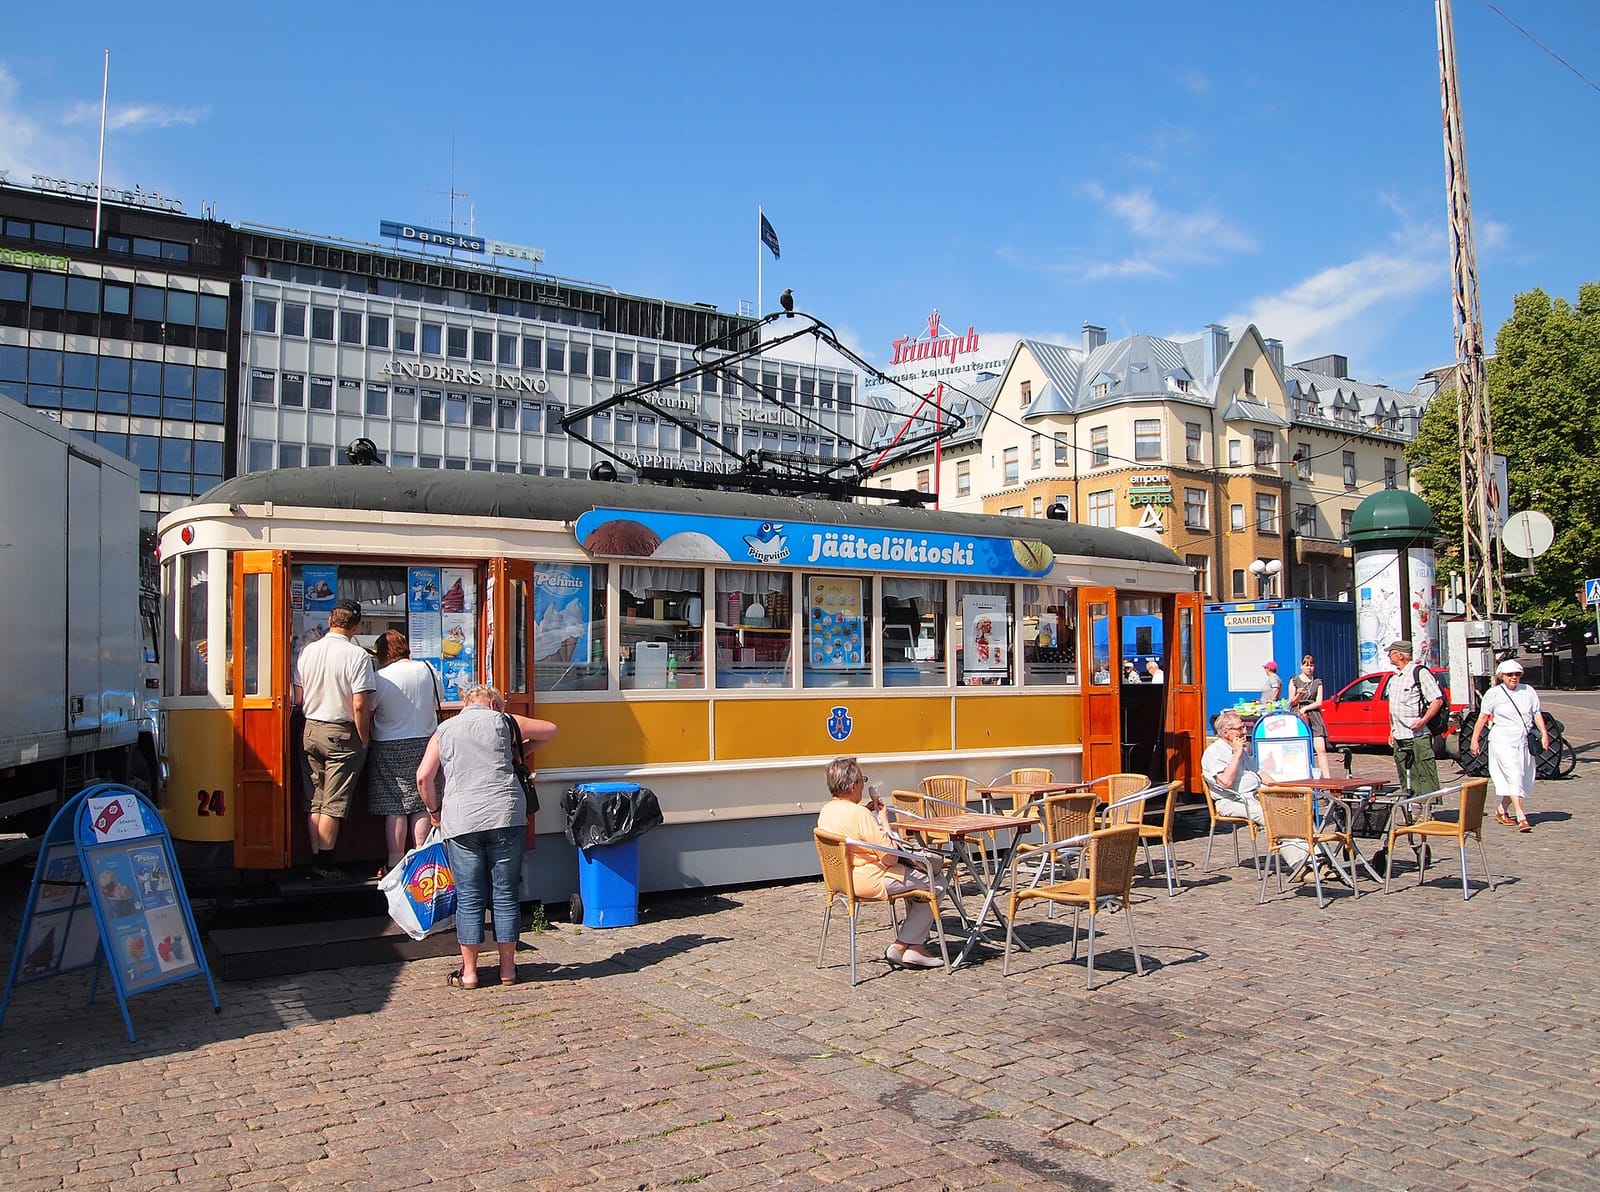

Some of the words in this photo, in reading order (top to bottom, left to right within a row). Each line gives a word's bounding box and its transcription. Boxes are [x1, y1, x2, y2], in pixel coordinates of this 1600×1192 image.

[402, 226, 480, 250] Danske
[491, 243, 543, 263] Bank
[890, 325, 979, 365] Triumph
[378, 360, 484, 386] ANDERS
[490, 370, 550, 394] INNO
[748, 547, 789, 562] Pingviini
[808, 532, 974, 565] Jäätelökioski
[1232, 615, 1271, 625] RAMIRENT
[198, 789, 225, 817] 24
[419, 872, 449, 897] 20
